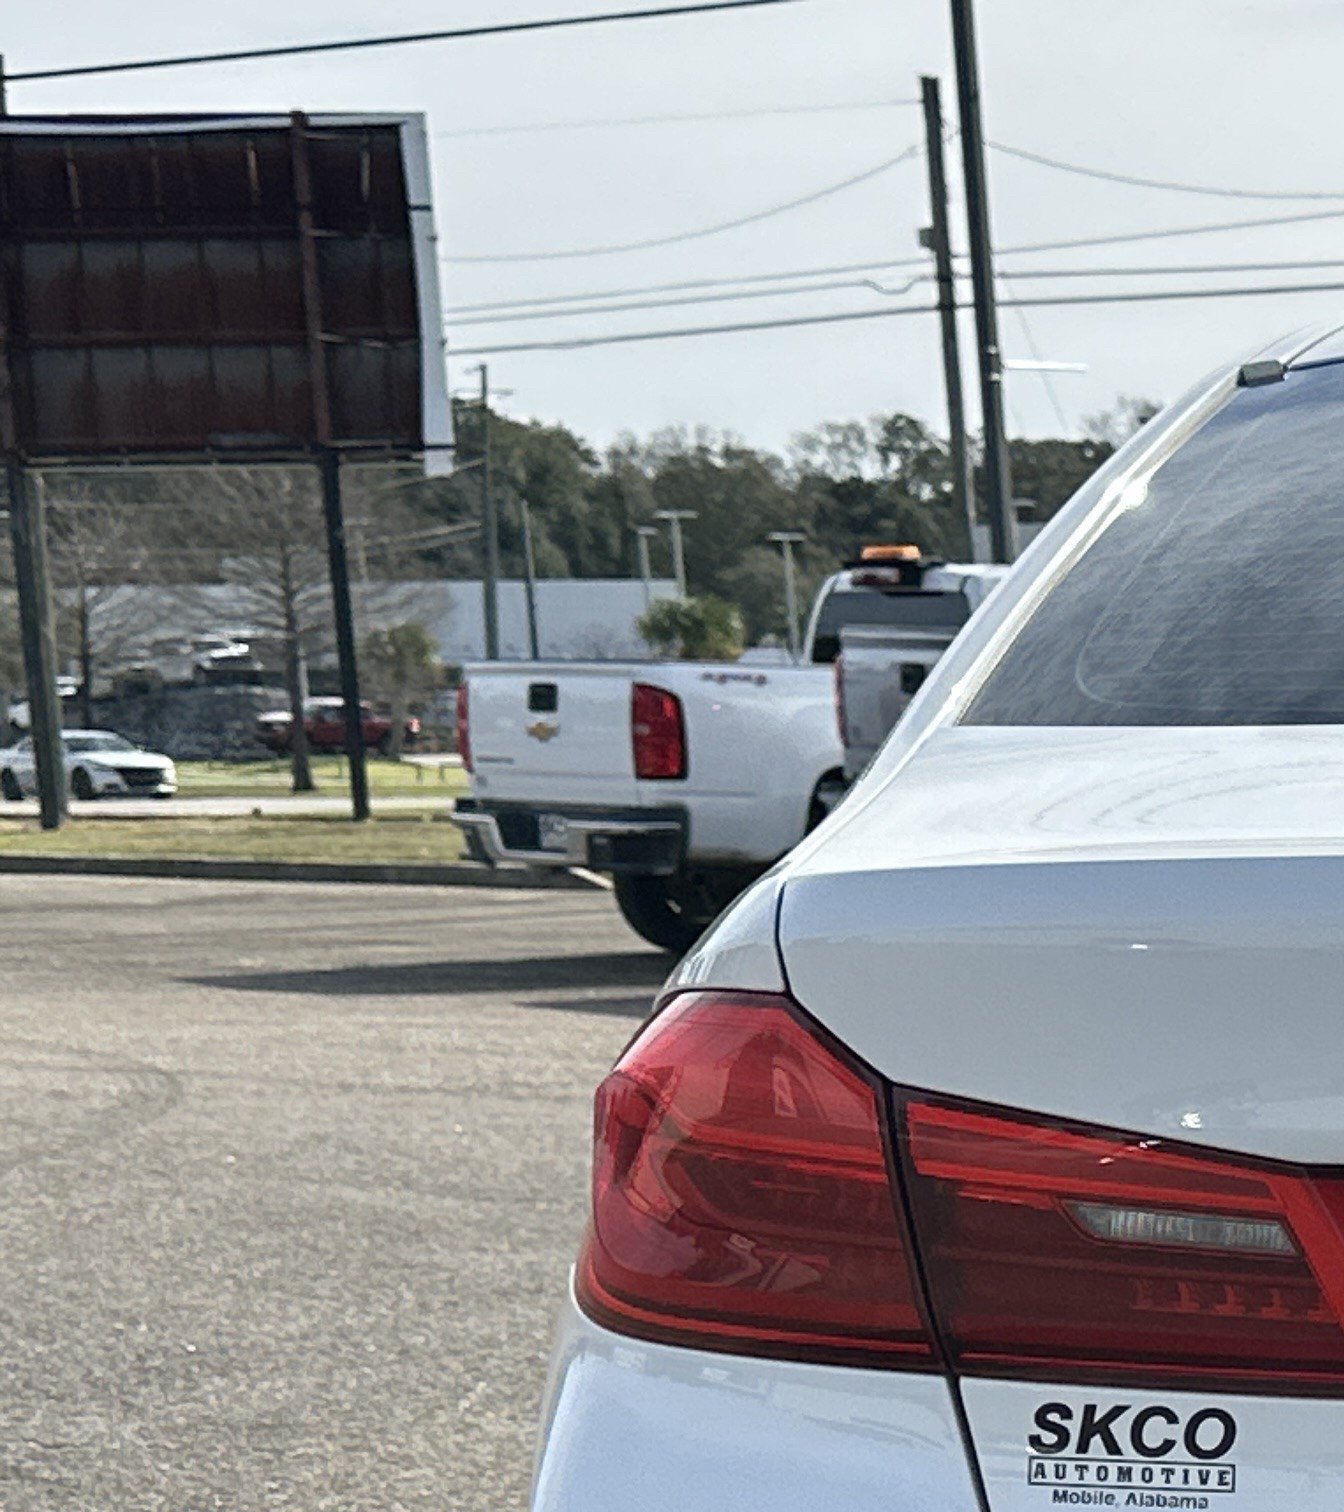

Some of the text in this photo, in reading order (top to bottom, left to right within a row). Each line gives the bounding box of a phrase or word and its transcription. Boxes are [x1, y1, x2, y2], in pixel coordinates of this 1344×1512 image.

[1028, 1402, 1237, 1460] SKCO
[1033, 1461, 1232, 1487] AUTOMOTIVE
[1052, 1489, 1209, 1509] Mobile, Alabama
